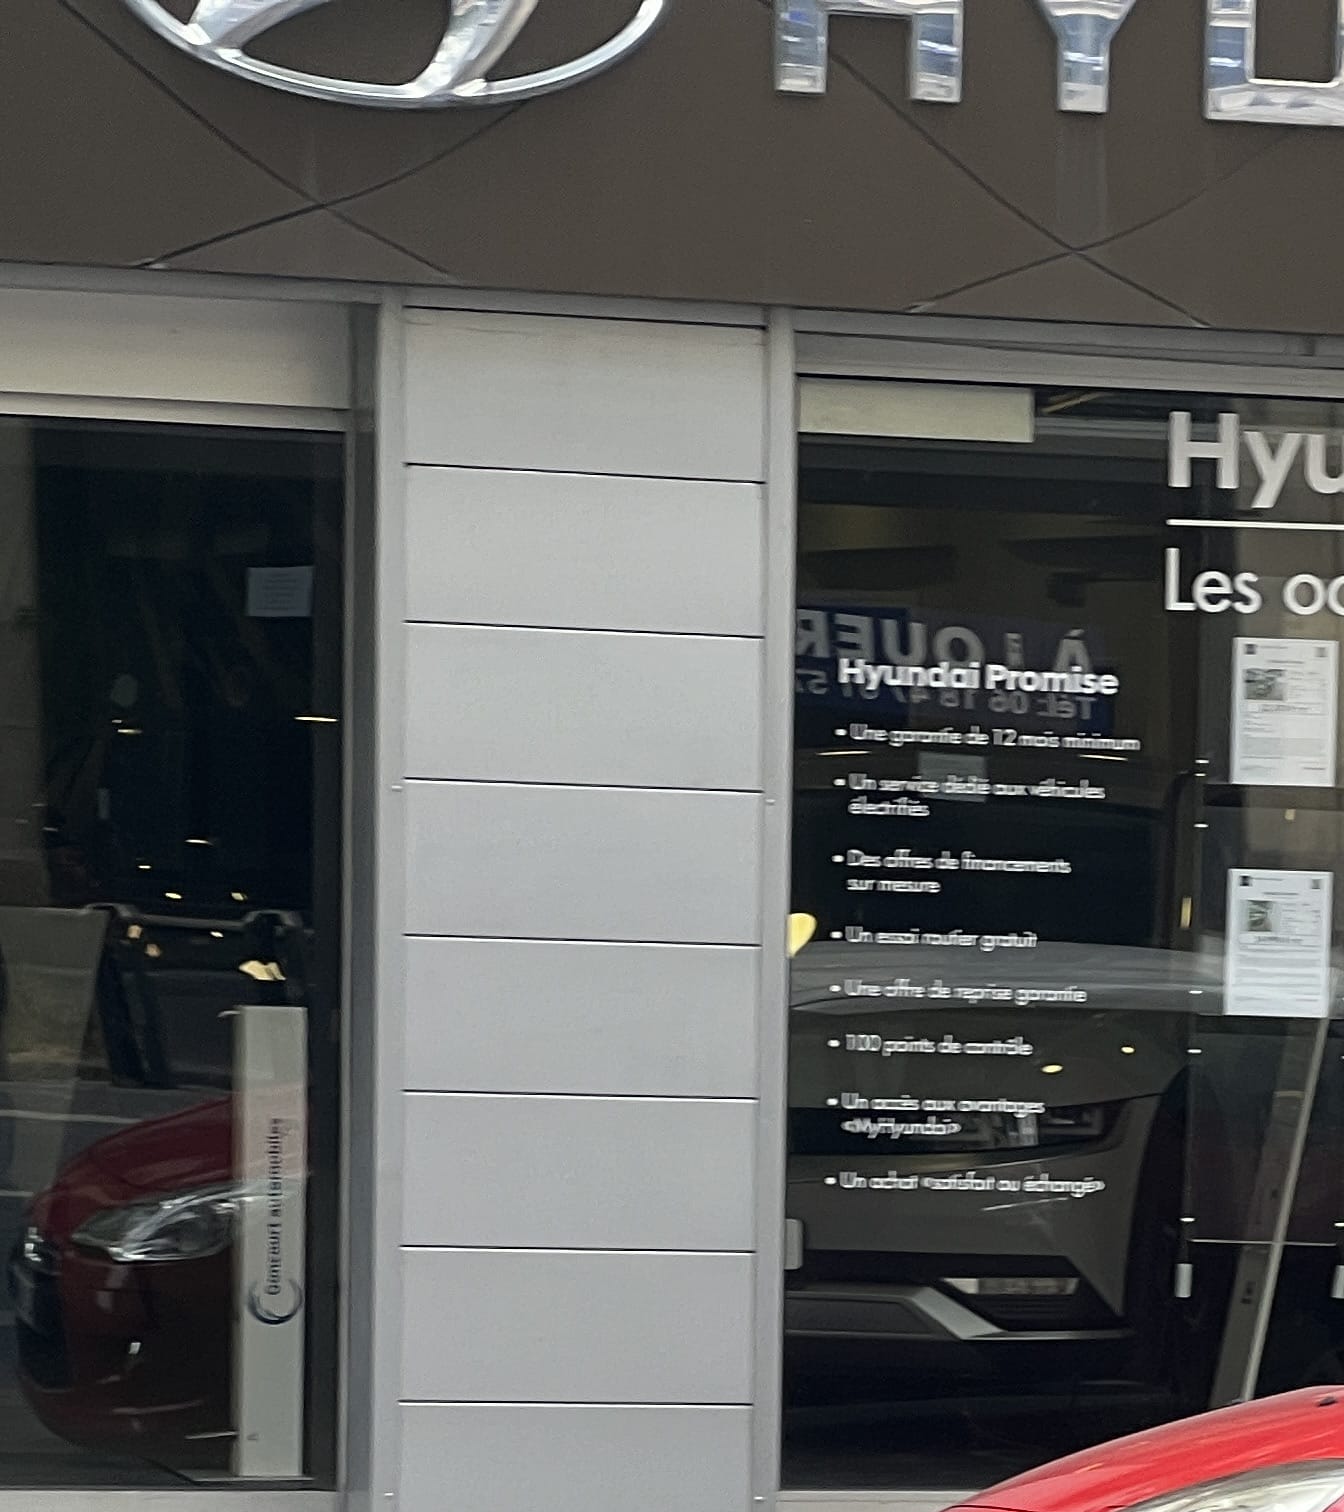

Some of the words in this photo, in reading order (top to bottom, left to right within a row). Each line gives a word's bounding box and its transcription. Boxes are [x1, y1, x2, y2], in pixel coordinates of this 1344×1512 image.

[1165, 548, 1260, 614] Les
[838, 659, 980, 691] Hyundai
[986, 665, 1119, 695] Promise
[850, 723, 888, 742] Une
[964, 726, 989, 745] de
[991, 728, 1017, 747] 12
[849, 773, 876, 791] Un
[847, 849, 881, 867] Des
[935, 851, 959, 870] de
[847, 879, 873, 891] sur
[877, 880, 941, 894] mesure
[845, 926, 873, 943] Un
[845, 979, 881, 997] Une
[927, 980, 951, 999] de
[846, 1034, 881, 1052] 100
[937, 1035, 961, 1054] de
[841, 1093, 868, 1110] Un
[840, 1171, 866, 1188] Un
